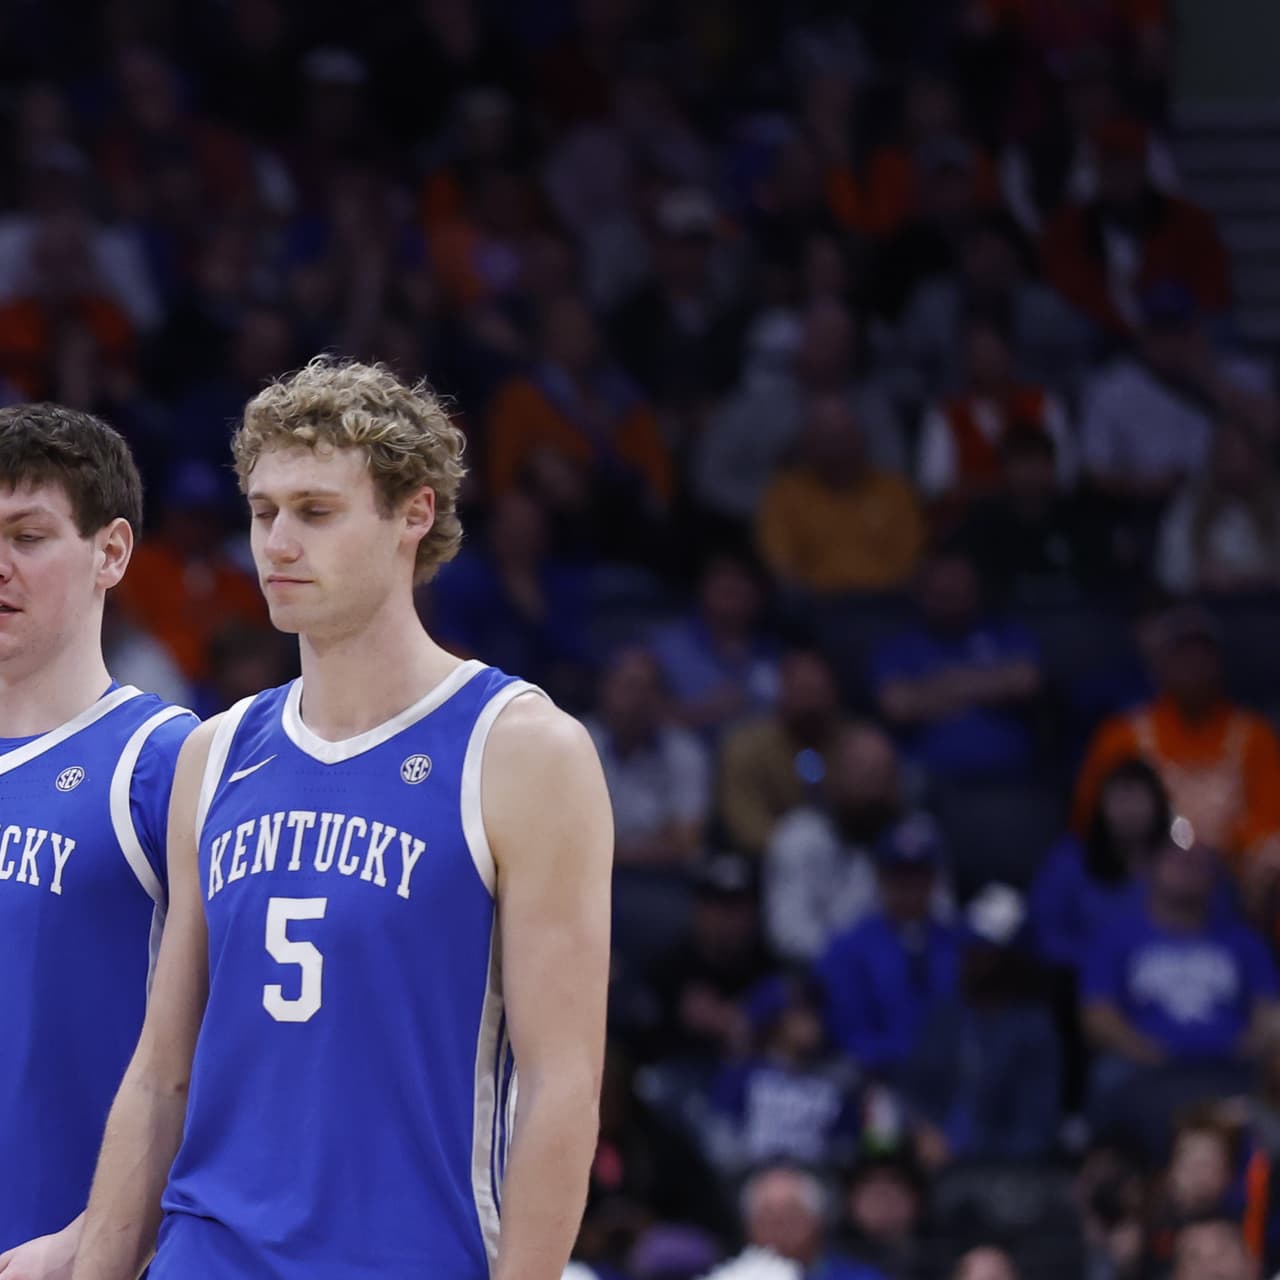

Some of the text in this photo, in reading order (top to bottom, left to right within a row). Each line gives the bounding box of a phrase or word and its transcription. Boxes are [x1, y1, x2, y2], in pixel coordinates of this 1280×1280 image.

[57, 768, 84, 790] SEC
[403, 756, 429, 783] SEC
[207, 810, 428, 901] KENTUCKY
[261, 897, 328, 1023] 5
